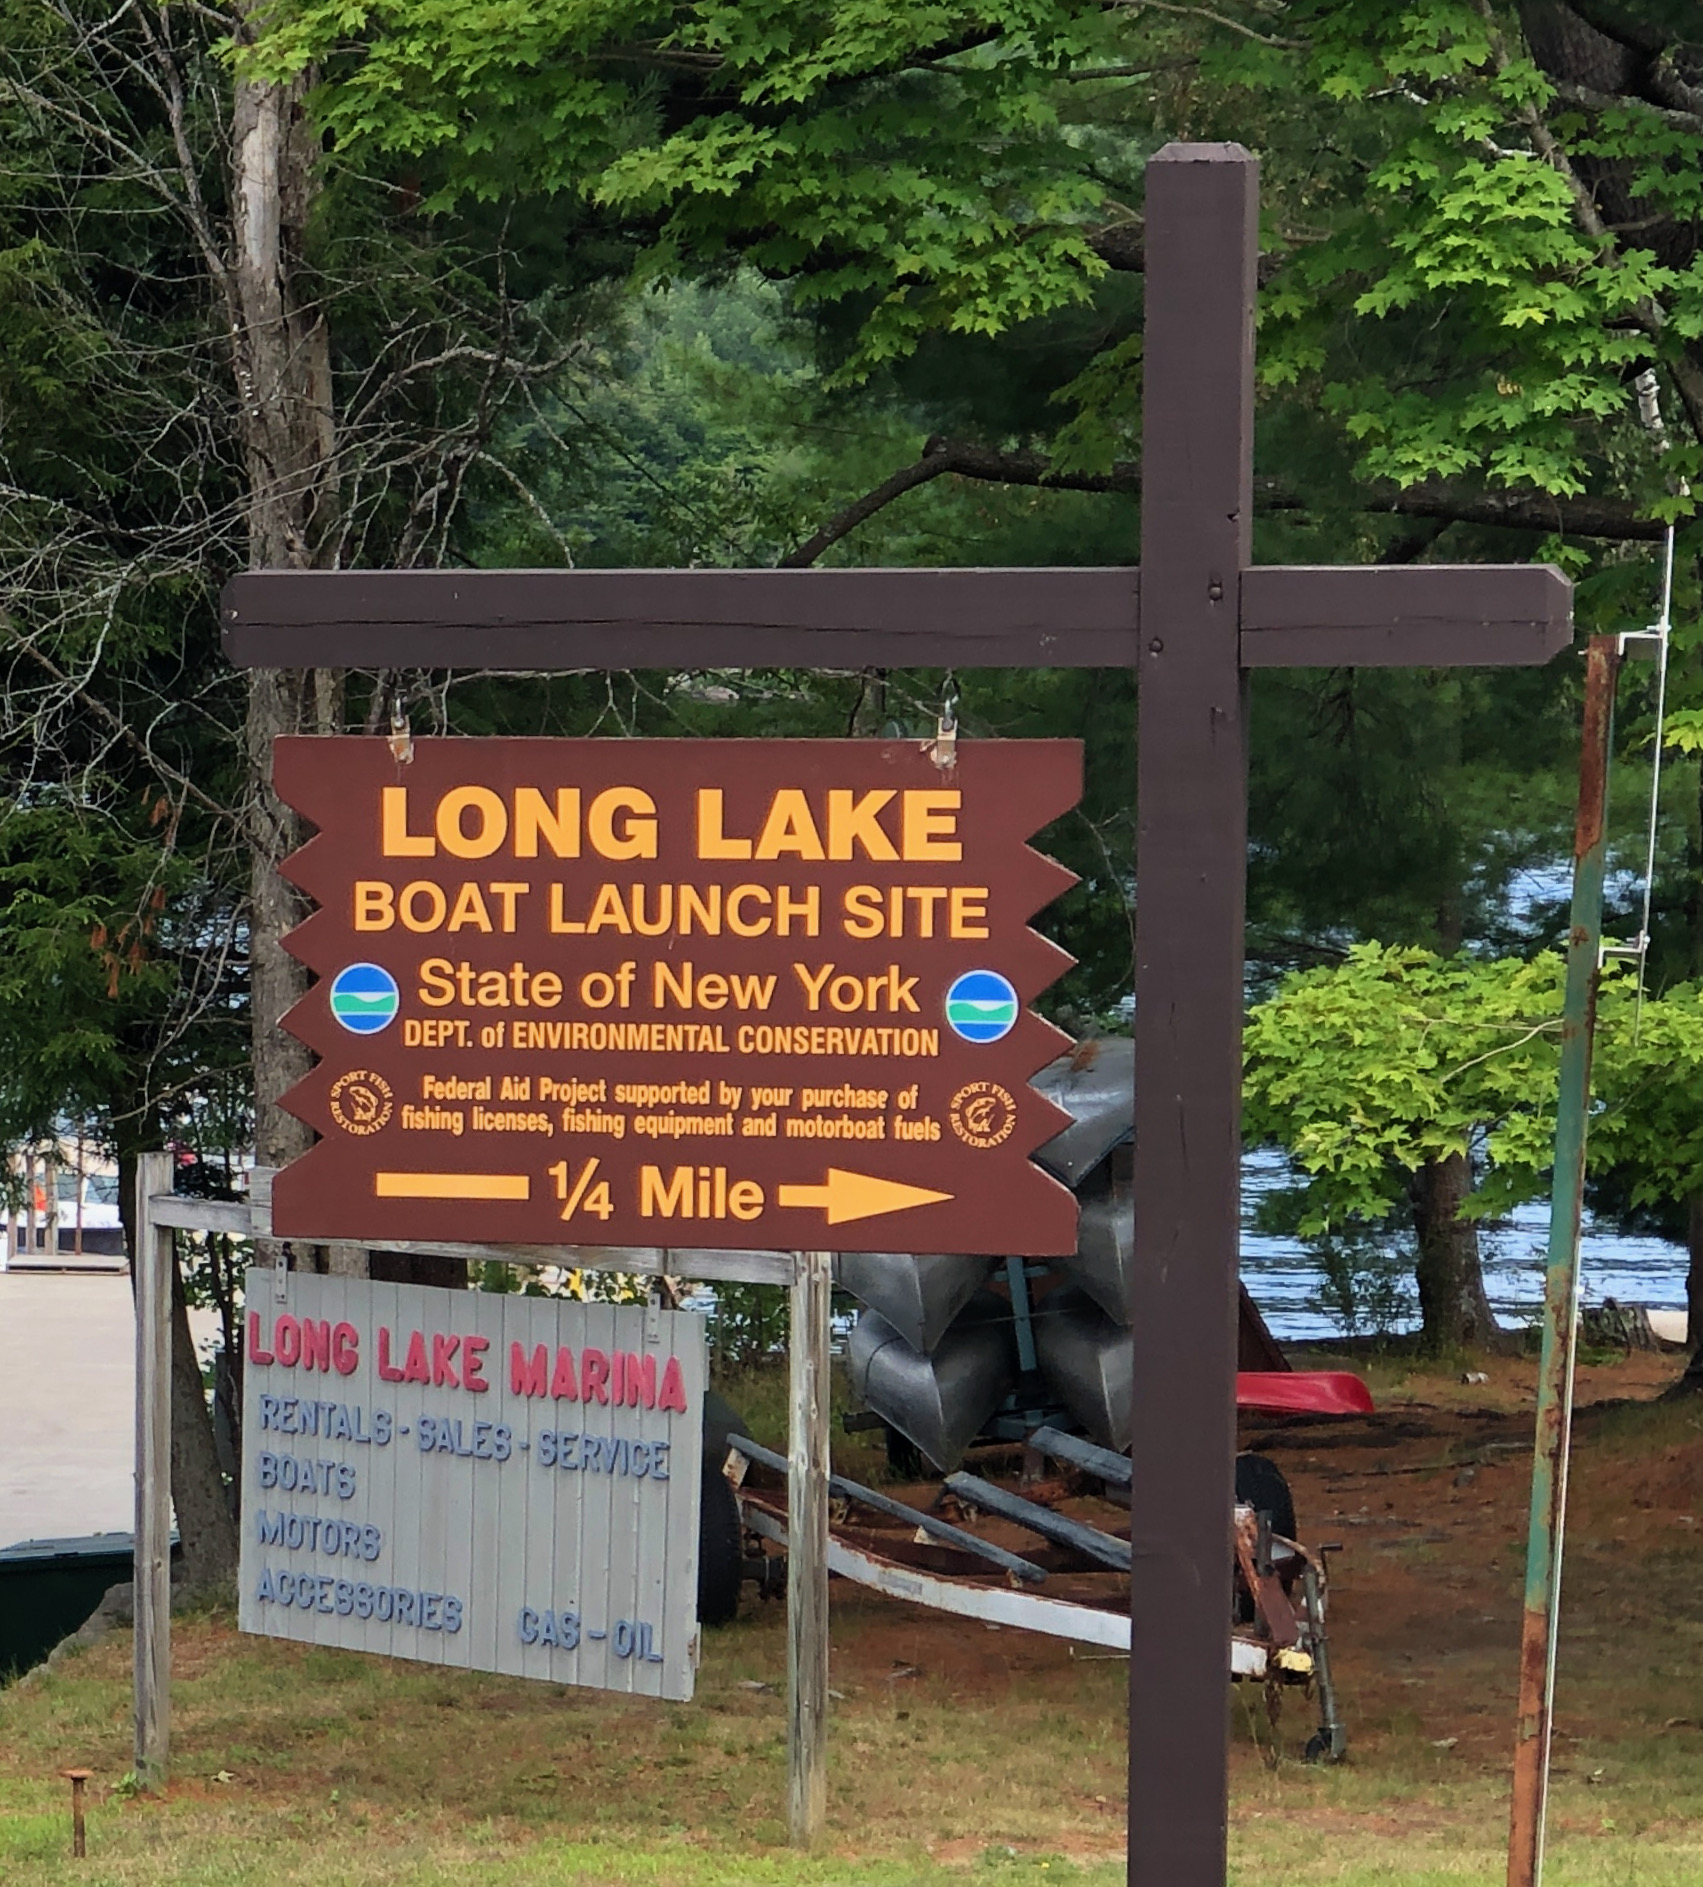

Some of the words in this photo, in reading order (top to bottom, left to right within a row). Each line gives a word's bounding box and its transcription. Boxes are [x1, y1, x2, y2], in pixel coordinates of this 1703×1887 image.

[382, 785, 658, 861] LONG
[697, 788, 963, 862] LAKE
[354, 880, 530, 933] BOAT
[550, 882, 820, 937] LAUNCH
[843, 885, 990, 939] SITE
[418, 957, 563, 1008] State
[580, 961, 636, 1008] of
[654, 961, 778, 1010] New
[794, 962, 921, 1013] York
[404, 1019, 473, 1048] DEPT.
[481, 1021, 506, 1049] of
[512, 1021, 731, 1053] ENVIRONMENTAL
[738, 1025, 939, 1057] CONSERVATION
[330, 1070, 368, 1099] SPORT
[369, 1072, 394, 1099] FISH
[423, 1075, 492, 1101] Federal
[499, 1075, 531, 1101] Aid
[539, 1076, 607, 1108] Project
[614, 1079, 711, 1109] supported
[719, 1080, 743, 1111] by
[750, 1087, 794, 1111] your
[801, 1083, 889, 1112] purchase
[897, 1083, 919, 1110] of
[951, 1081, 990, 1110] SPORT
[991, 1084, 1017, 1111] FISH
[330, 1101, 393, 1135] RESTORATION
[401, 1104, 464, 1136] fishing
[472, 1105, 554, 1138] licenses,
[561, 1106, 626, 1139] fishing
[633, 1109, 734, 1140] equipment
[741, 1112, 777, 1137] and
[786, 1113, 886, 1140] motorboat
[893, 1114, 941, 1141] fuels
[950, 1113, 1016, 1148] RESTORATION
[640, 1165, 765, 1220] Mile
[248, 1312, 358, 1373] LONG
[377, 1328, 487, 1390] LAKE
[510, 1341, 686, 1411] MARINA
[260, 1393, 392, 1446] RENTALS
[417, 1412, 512, 1462] SALES
[539, 1428, 670, 1481] SERVICE
[260, 1451, 356, 1500] BOATS
[258, 1509, 381, 1562] MOTORS
[257, 1567, 463, 1635] ACCESSORIES
[517, 1606, 580, 1651] GAS
[614, 1619, 664, 1663] OIL
